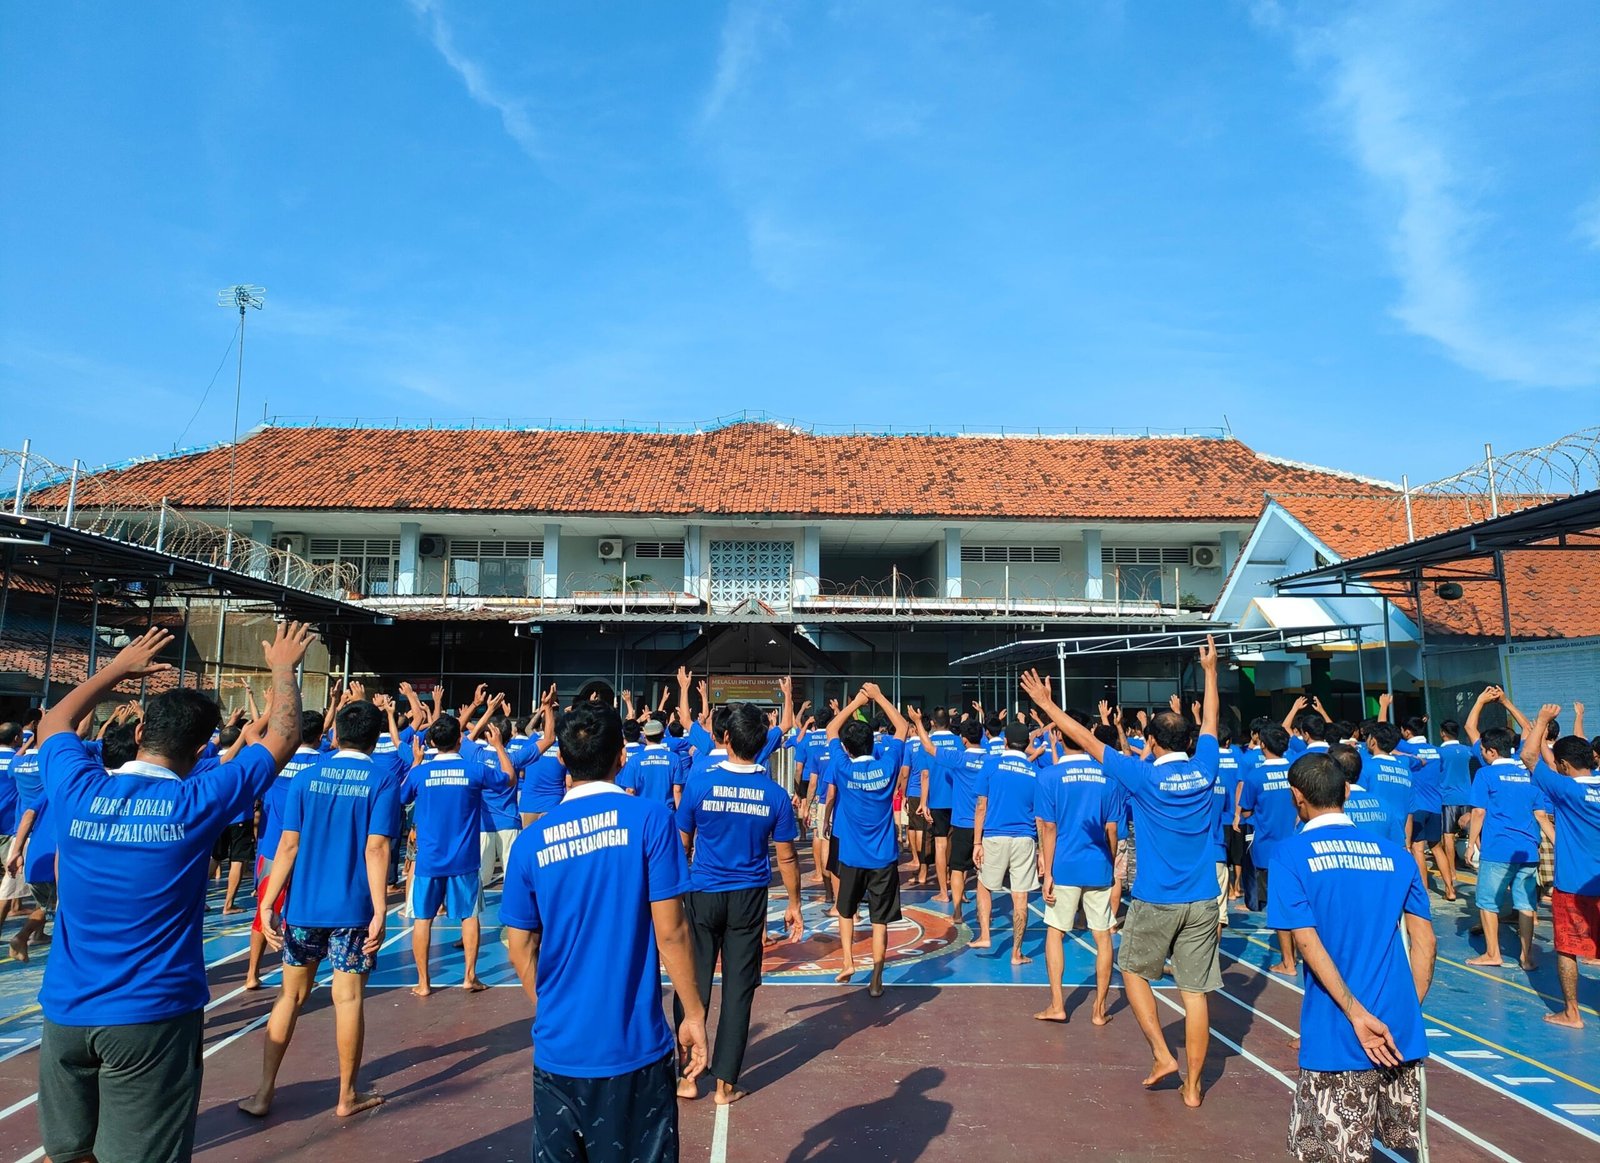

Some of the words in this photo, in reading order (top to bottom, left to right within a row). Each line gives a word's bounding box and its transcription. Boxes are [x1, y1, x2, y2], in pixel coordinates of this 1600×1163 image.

[713, 785, 737, 798] WARGA
[739, 787, 764, 800] BINAAN
[90, 796, 131, 816] WARGA
[133, 798, 174, 816] BINAAN
[702, 800, 725, 812] RUTAN
[726, 801, 770, 816] PEKALONGAN
[69, 819, 107, 841] RUTAN
[107, 823, 185, 843] PEKALONGAN
[543, 819, 581, 844] WARGA
[580, 810, 618, 834] BINAAN
[536, 842, 568, 868] RUTAN
[568, 828, 628, 858] PEKALONGAN
[1311, 840, 1347, 855] WARGA
[1345, 840, 1382, 855] BINAAN
[1308, 855, 1339, 873] RUTAN
[1338, 855, 1394, 872] PEKALONGAN
